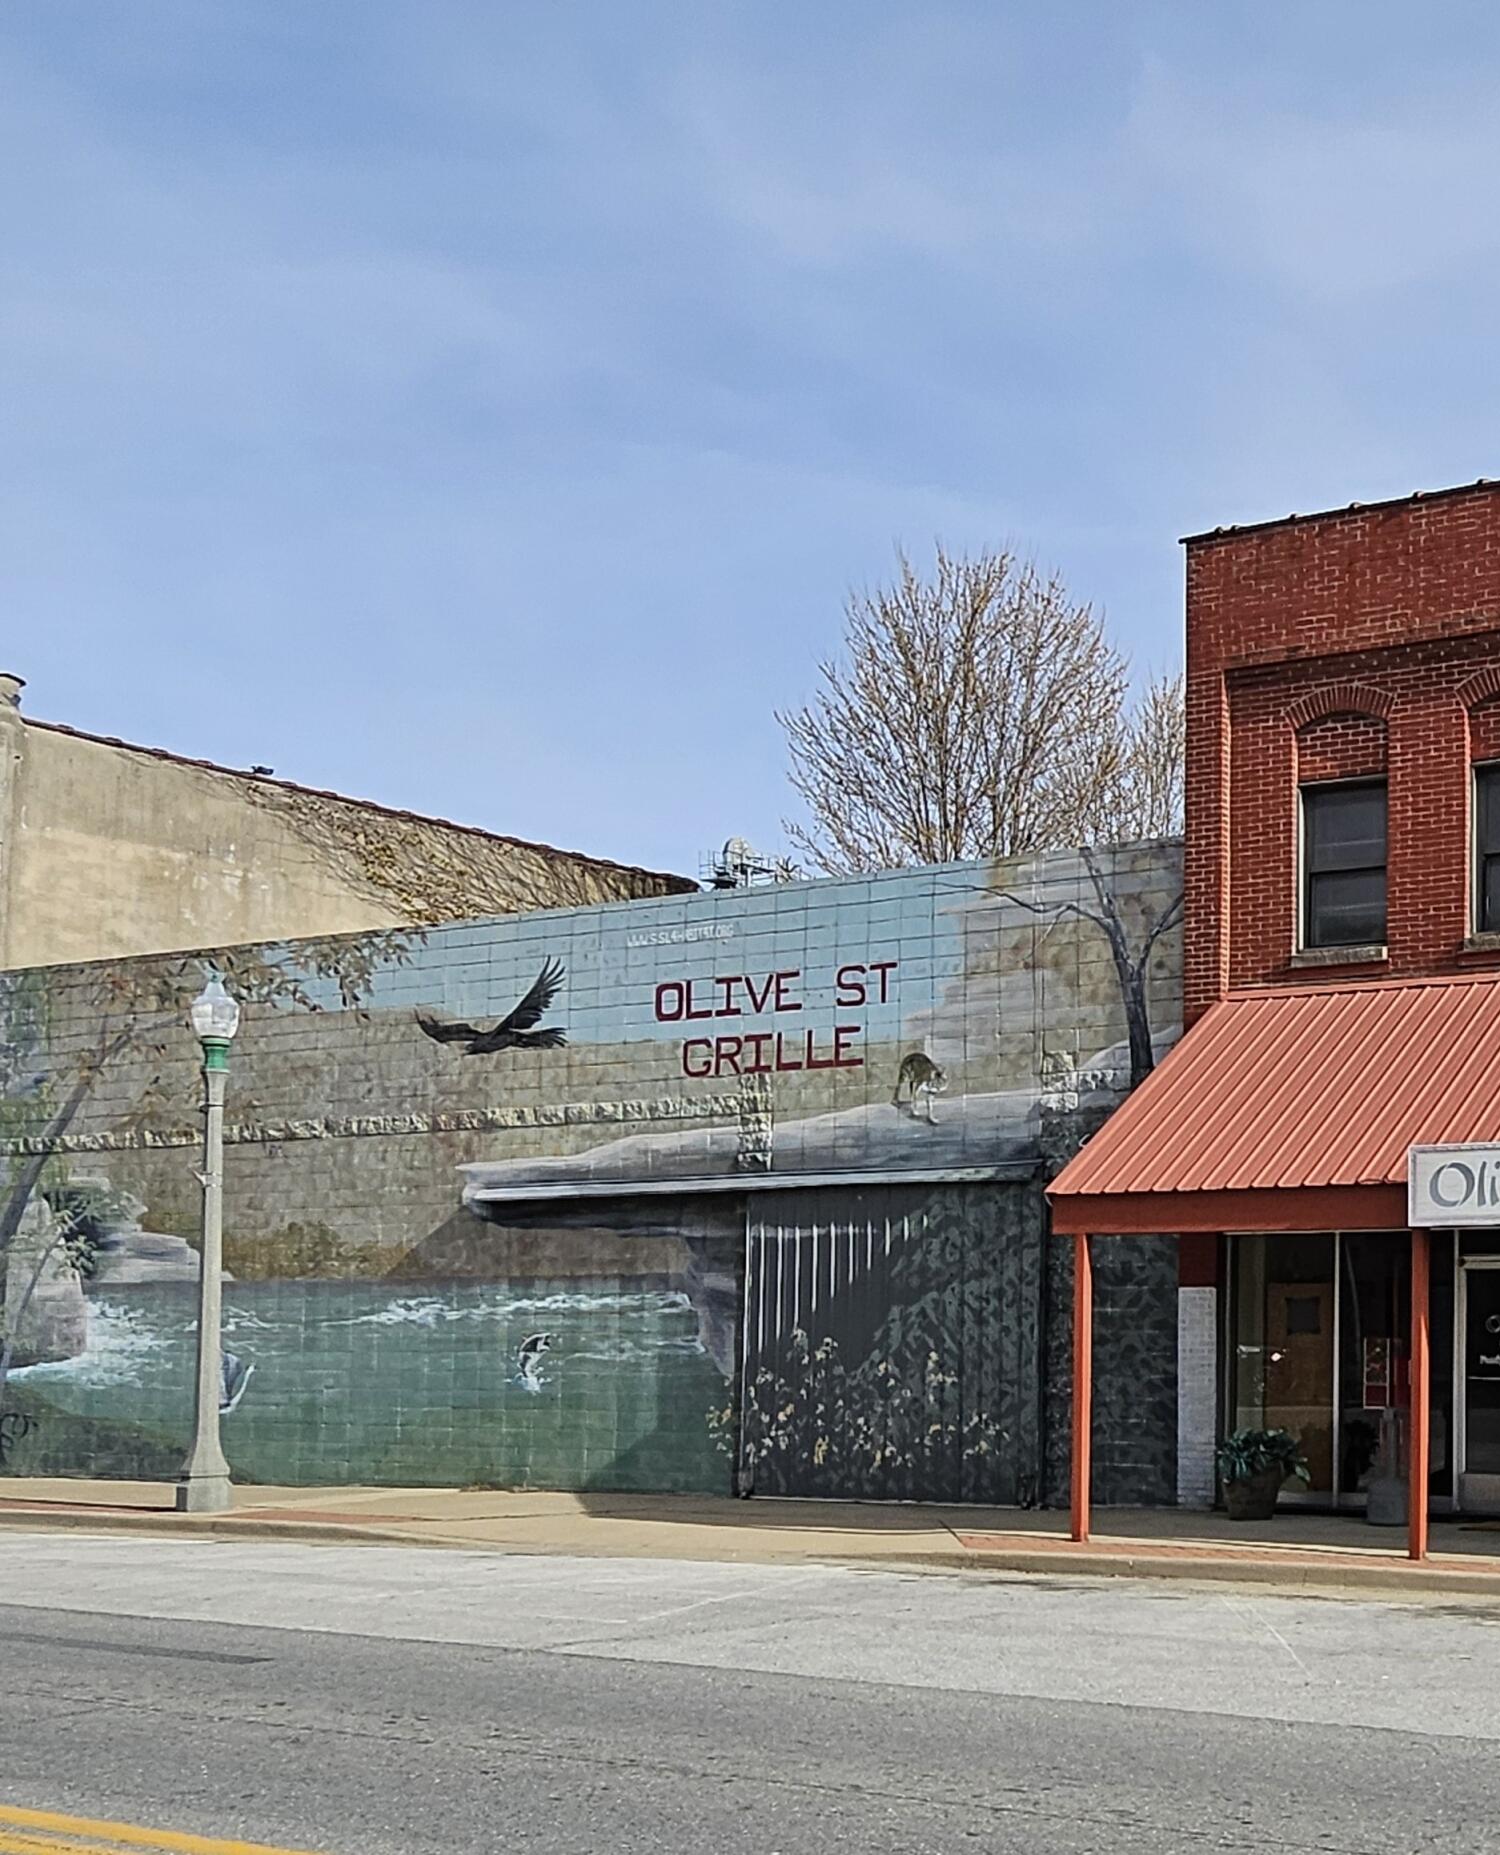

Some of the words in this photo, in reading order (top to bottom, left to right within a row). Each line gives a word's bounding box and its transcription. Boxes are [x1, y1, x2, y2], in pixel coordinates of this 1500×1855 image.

[655, 971, 803, 1022] OLIVE
[836, 962, 898, 1007] ST
[682, 1026, 864, 1078] GRILLE
